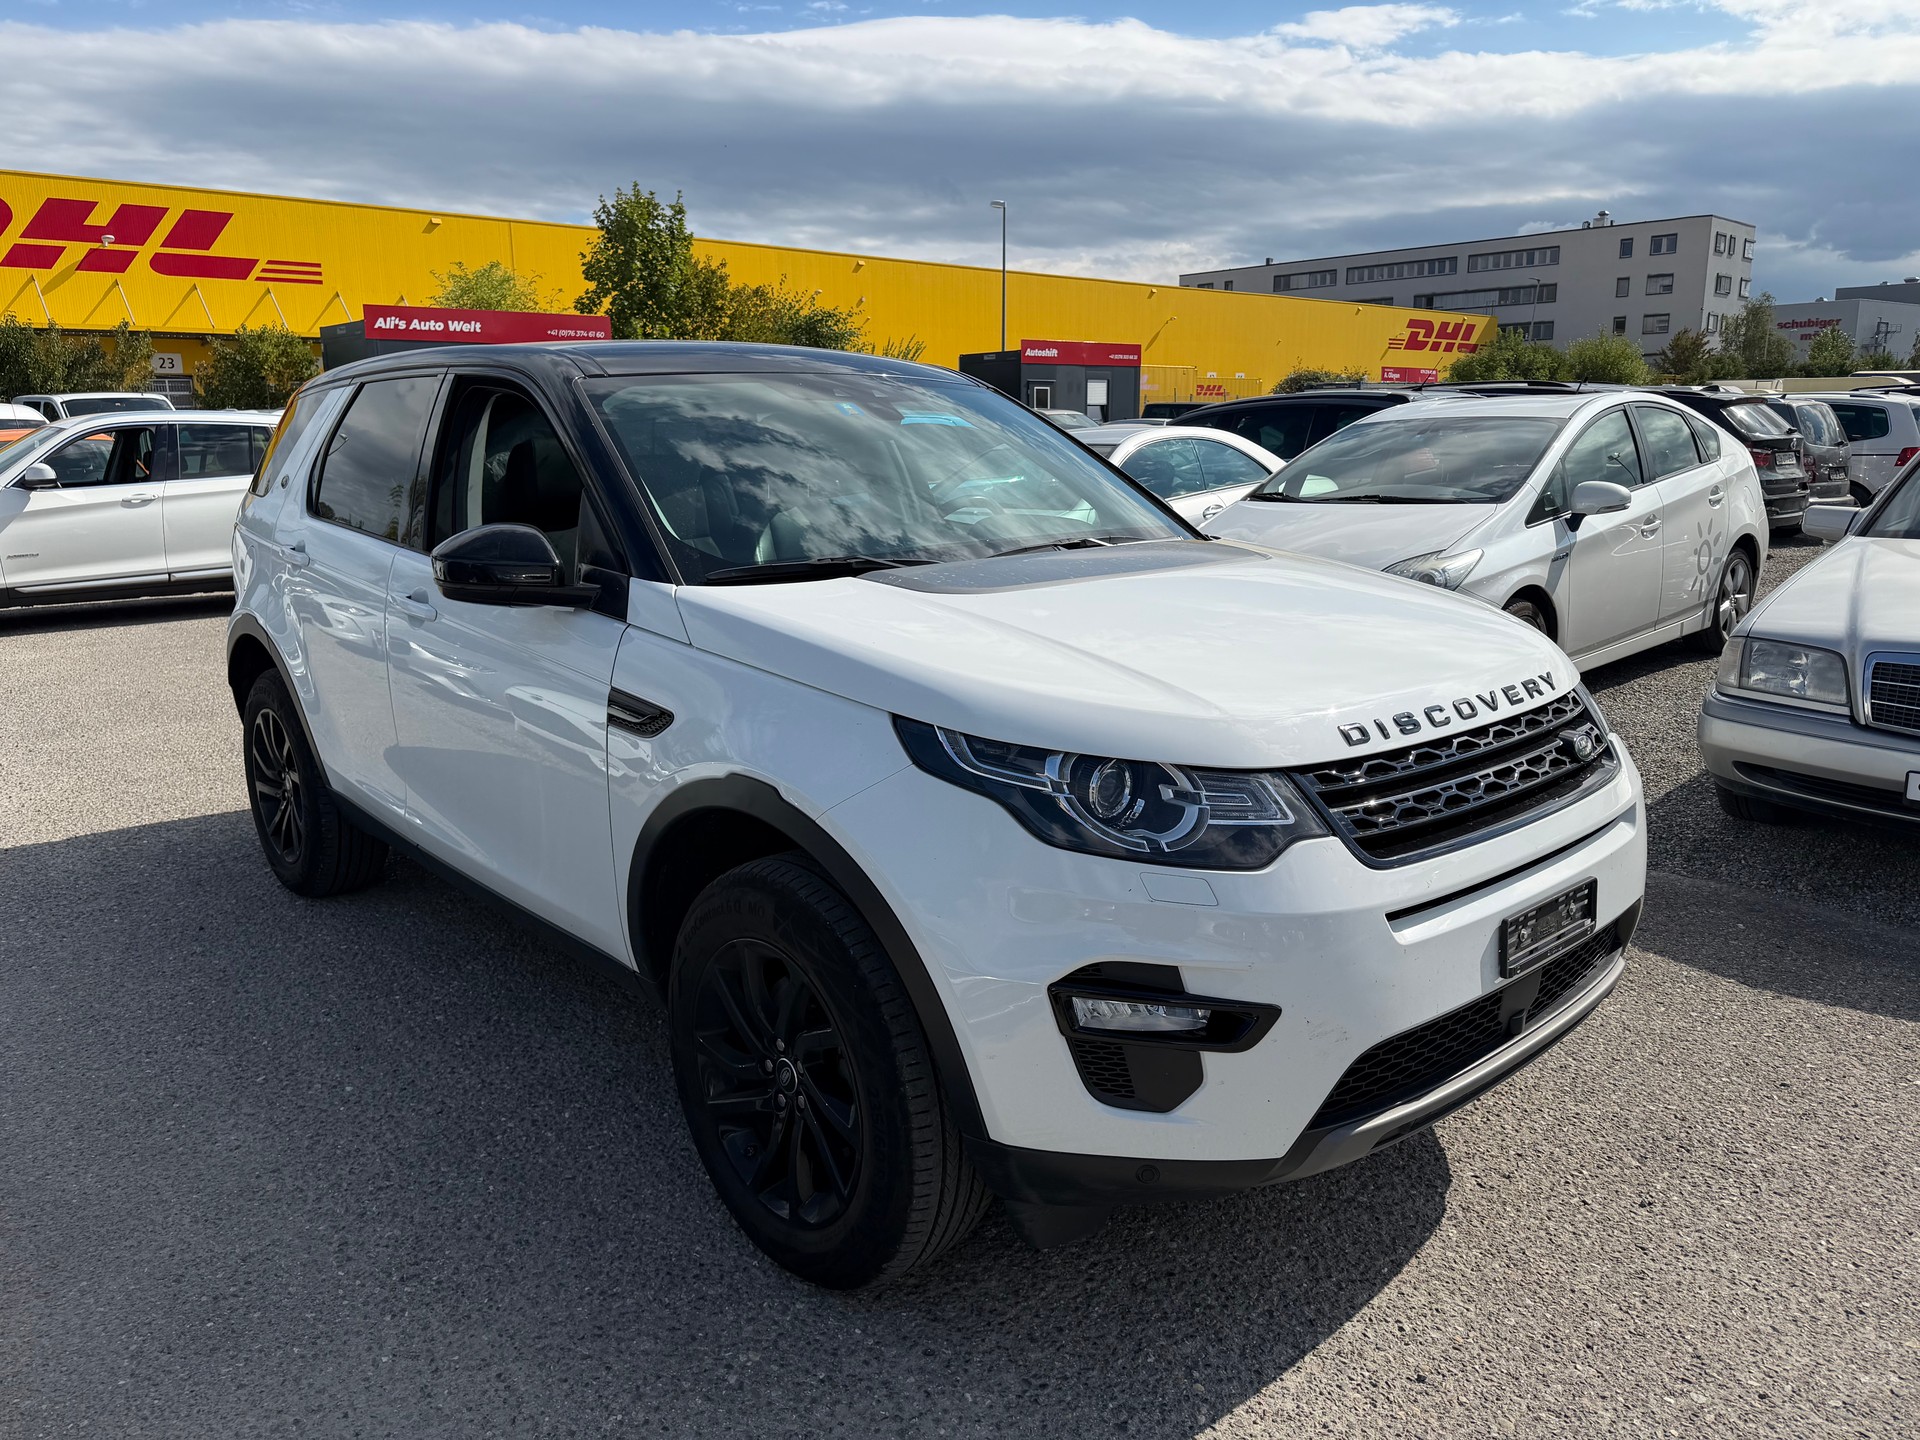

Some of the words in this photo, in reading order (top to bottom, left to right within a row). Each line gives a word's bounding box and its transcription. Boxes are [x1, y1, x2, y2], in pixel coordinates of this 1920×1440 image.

[0, 197, 260, 281] HL
[409, 319, 445, 331] Auto
[448, 320, 482, 333] Welt
[1776, 318, 1842, 330] schubiger
[1403, 319, 1479, 354] DHL
[1025, 347, 1059, 357] Autoshift
[159, 358, 175, 369] 23
[1196, 384, 1224, 397] DHL
[1337, 671, 1557, 747] DISCOVERY
